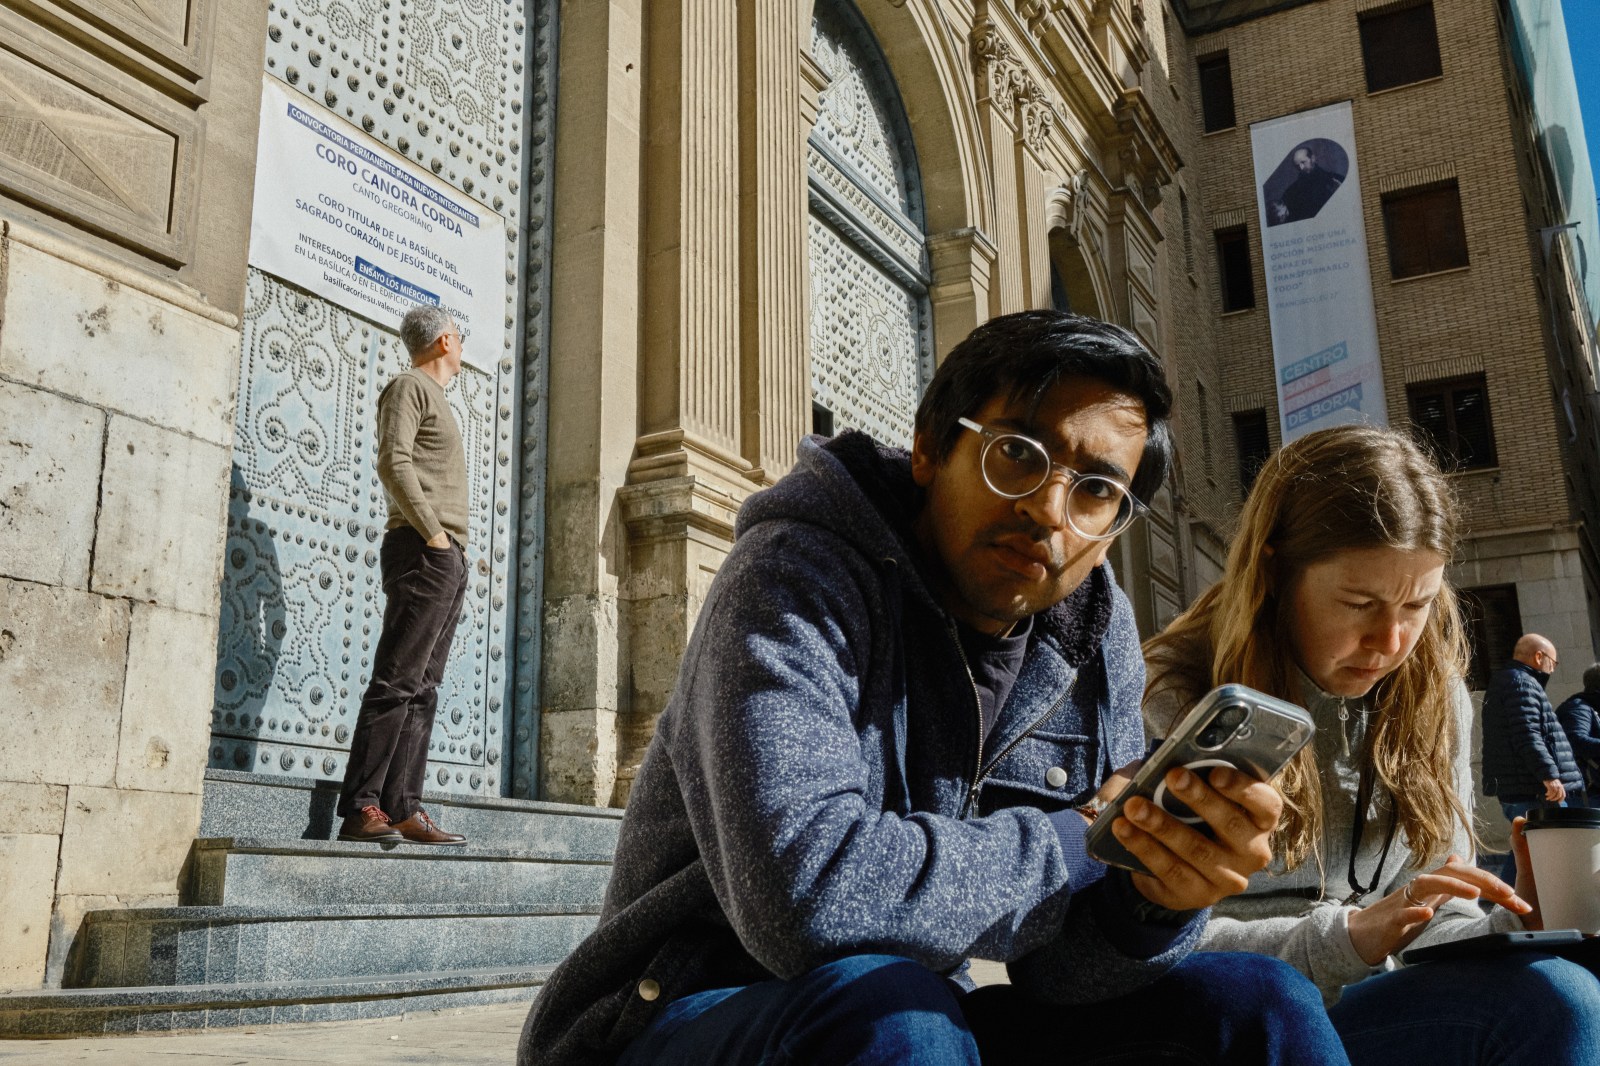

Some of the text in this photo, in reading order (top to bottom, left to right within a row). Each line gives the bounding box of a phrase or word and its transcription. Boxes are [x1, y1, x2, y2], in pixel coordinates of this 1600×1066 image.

[291, 107, 478, 224] CONVOCATORIA PERMANENTE PARA NUEVOS INTEGRANTES
[316, 143, 463, 238] CORO CANORA CORDA
[296, 199, 473, 298] SAGRADO CORAZÓN DE JESÚS DE VALENCIA
[318, 193, 458, 275] CORO TITULAR DE LA BASÍLICA DEL
[353, 182, 433, 233] CANTO GREGORIANO
[294, 244, 306, 256] EN
[307, 250, 317, 262] LA
[318, 256, 351, 279] BASÍLICA
[352, 272, 358, 282] O
[359, 276, 369, 288] EN
[370, 281, 379, 293] EL
[380, 286, 409, 307] EDIFICIO
[299, 232, 354, 267] INTERESADOS:
[360, 263, 385, 283] ENSAYO
[386, 277, 399, 291] LOS
[400, 285, 437, 307] MIÉRCOLES
[448, 306, 470, 323] HORAS
[1284, 346, 1344, 380] CENTRO
[1288, 388, 1360, 427] DE BORJA
